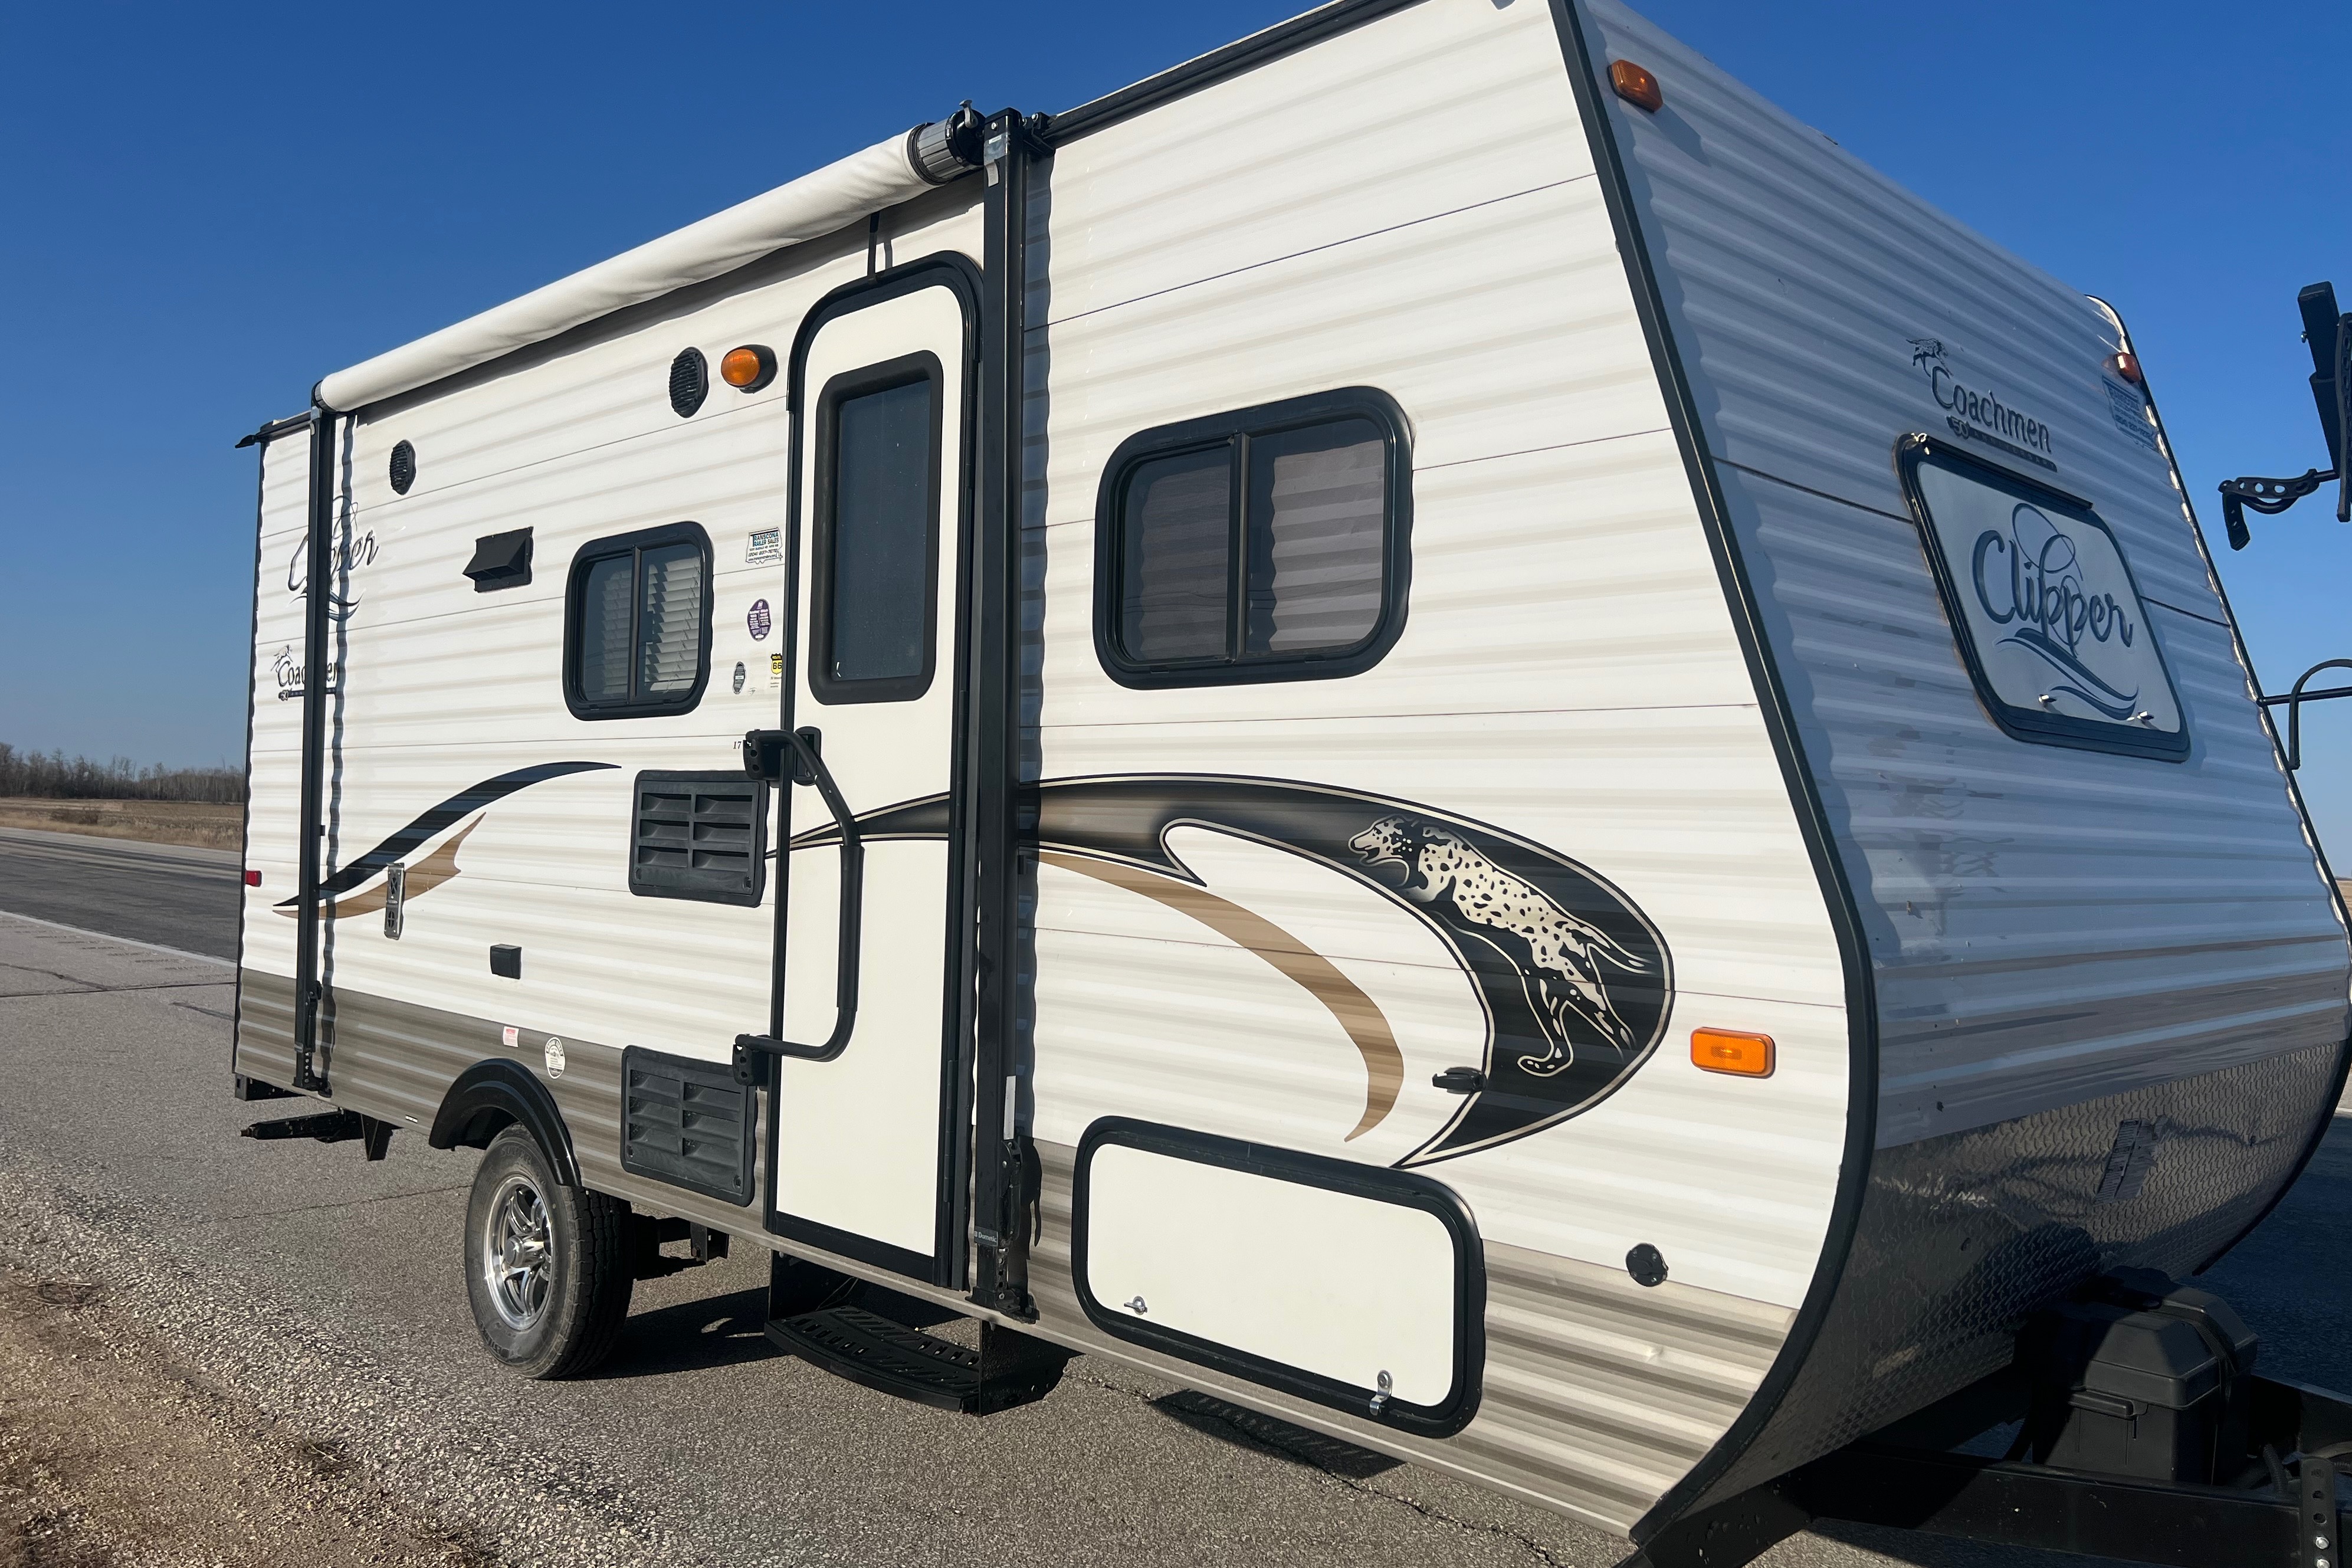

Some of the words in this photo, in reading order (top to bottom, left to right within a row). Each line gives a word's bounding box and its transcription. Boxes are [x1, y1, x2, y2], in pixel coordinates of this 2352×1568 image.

[1931, 365, 2052, 453] Coachmen
[1951, 415, 1969, 439] 50
[1972, 503, 2134, 659] Clipper
[733, 741, 742, 749] 17
